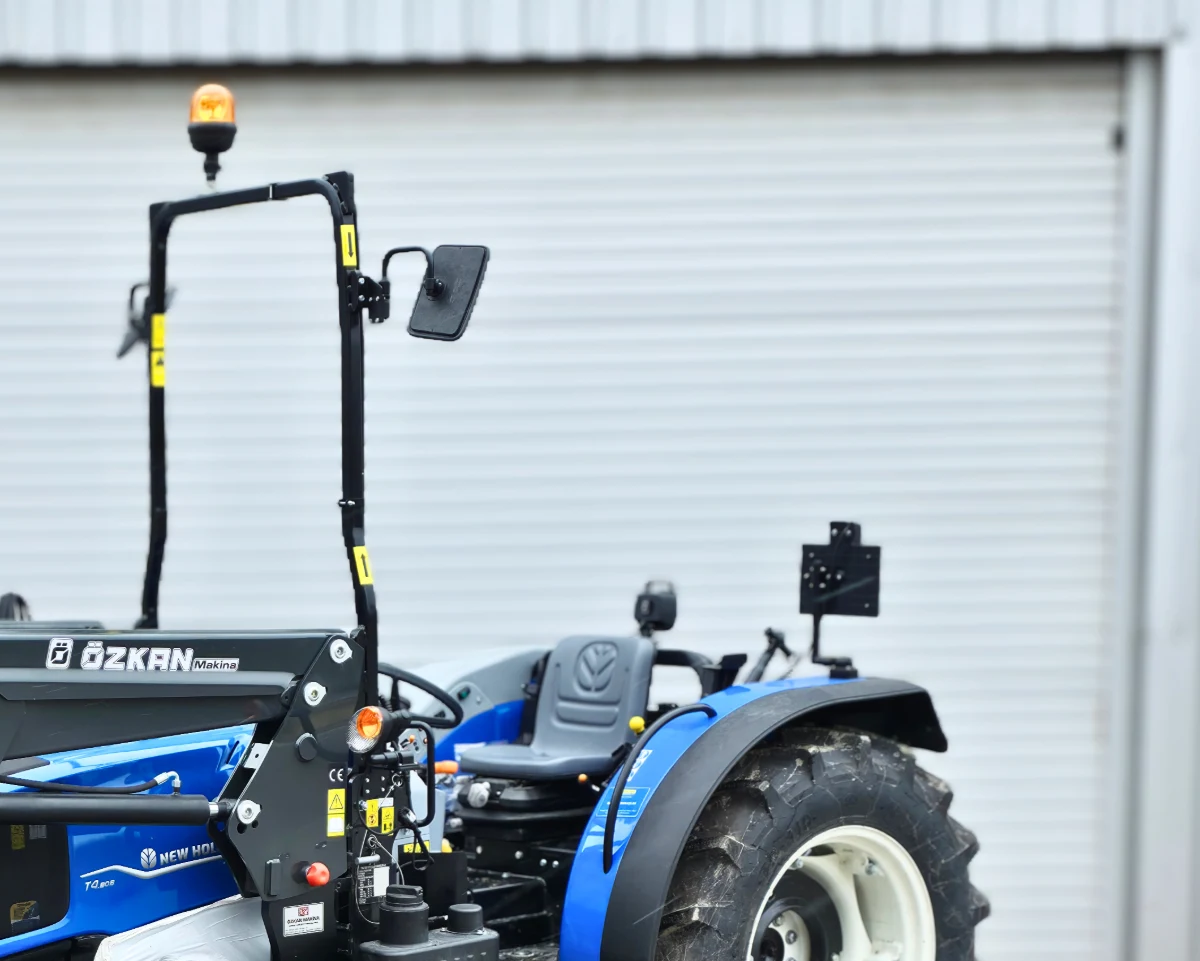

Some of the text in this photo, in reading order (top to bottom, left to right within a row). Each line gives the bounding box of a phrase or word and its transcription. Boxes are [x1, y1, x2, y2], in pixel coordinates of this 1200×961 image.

[80, 640, 194, 672] ÖZKAN
[194, 660, 238, 671] Makina
[329, 768, 344, 782] CE
[160, 847, 189, 866] NEW
